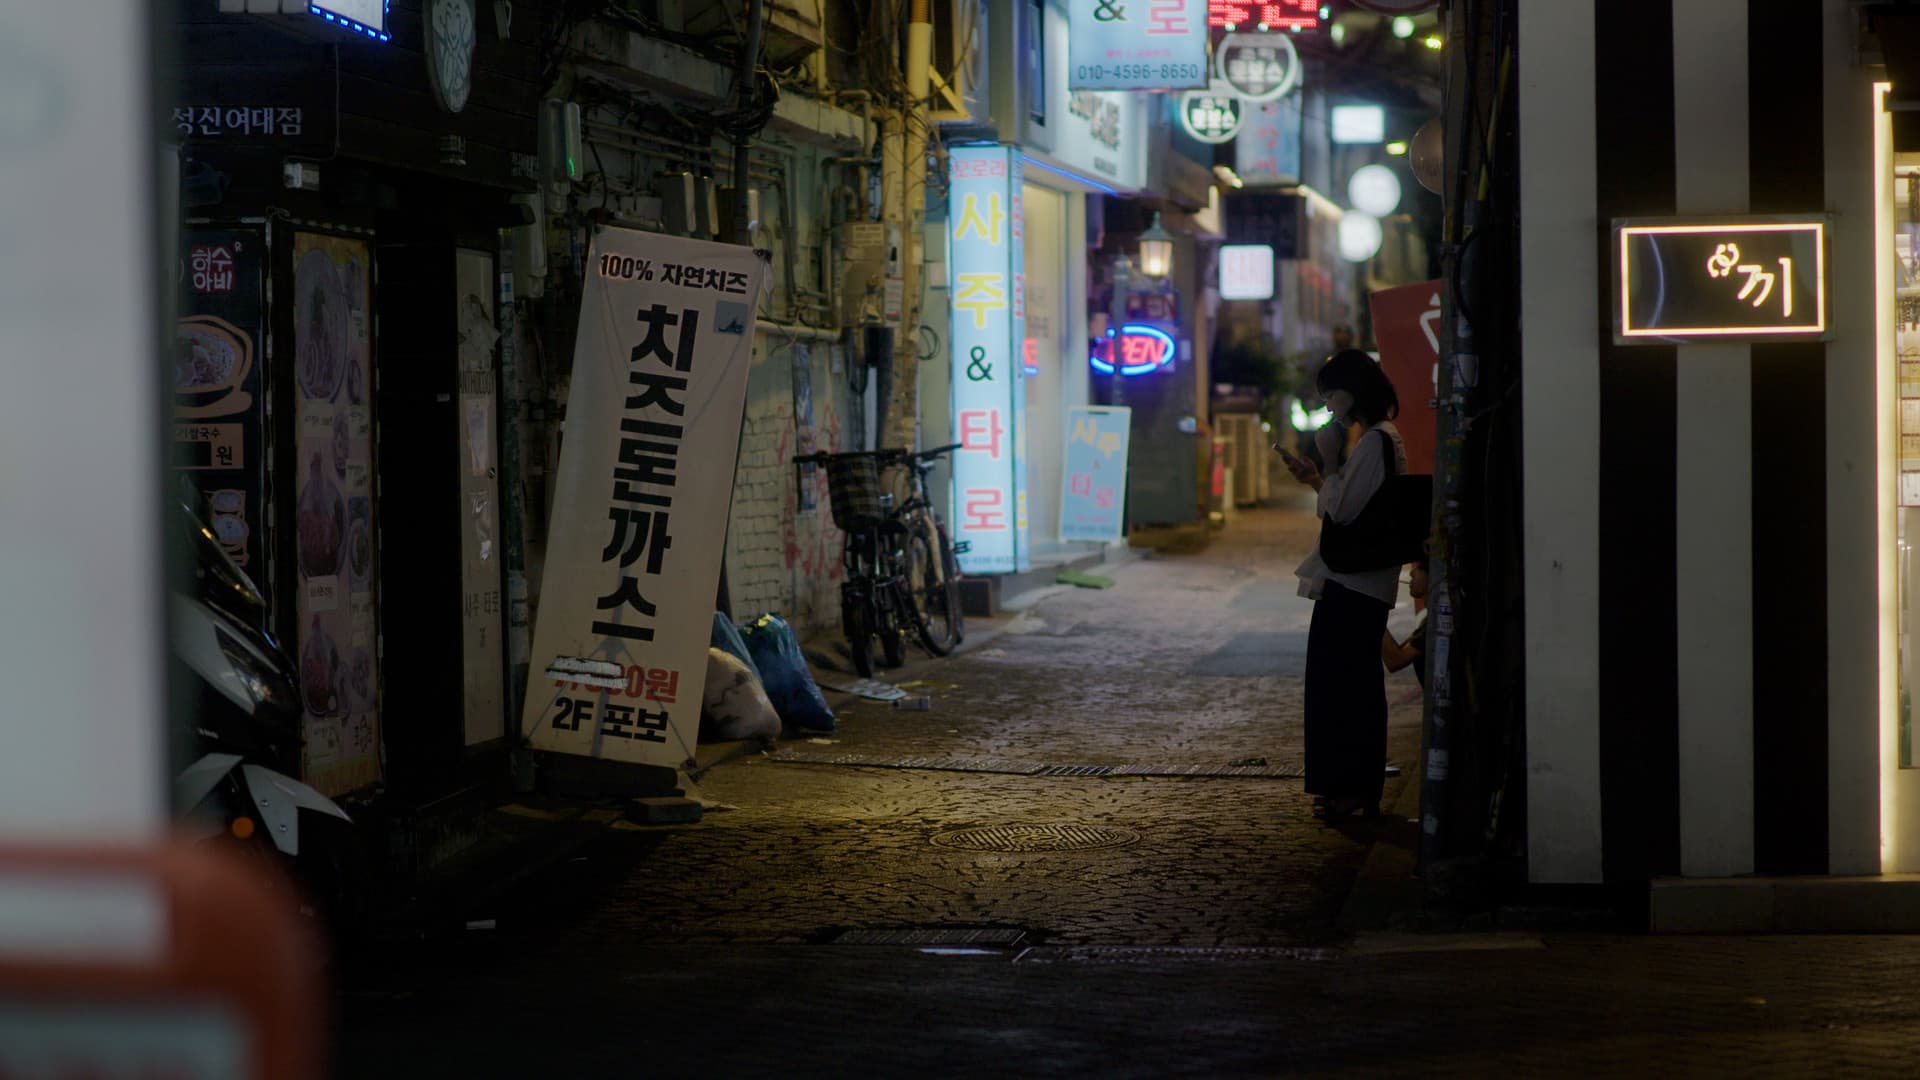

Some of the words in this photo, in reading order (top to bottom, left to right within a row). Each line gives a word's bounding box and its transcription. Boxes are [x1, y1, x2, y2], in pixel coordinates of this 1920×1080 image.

[1078, 64, 1199, 80] 010-4596-8650
[171, 106, 304, 136] 성신여대점
[193, 271, 233, 292] 아비
[600, 254, 654, 281] 100%
[660, 263, 748, 294] 자연치즈
[215, 446, 233, 466] 원
[592, 303, 699, 642] 치즈돈까스
[552, 697, 594, 731] 2F
[600, 703, 669, 743] 포보
